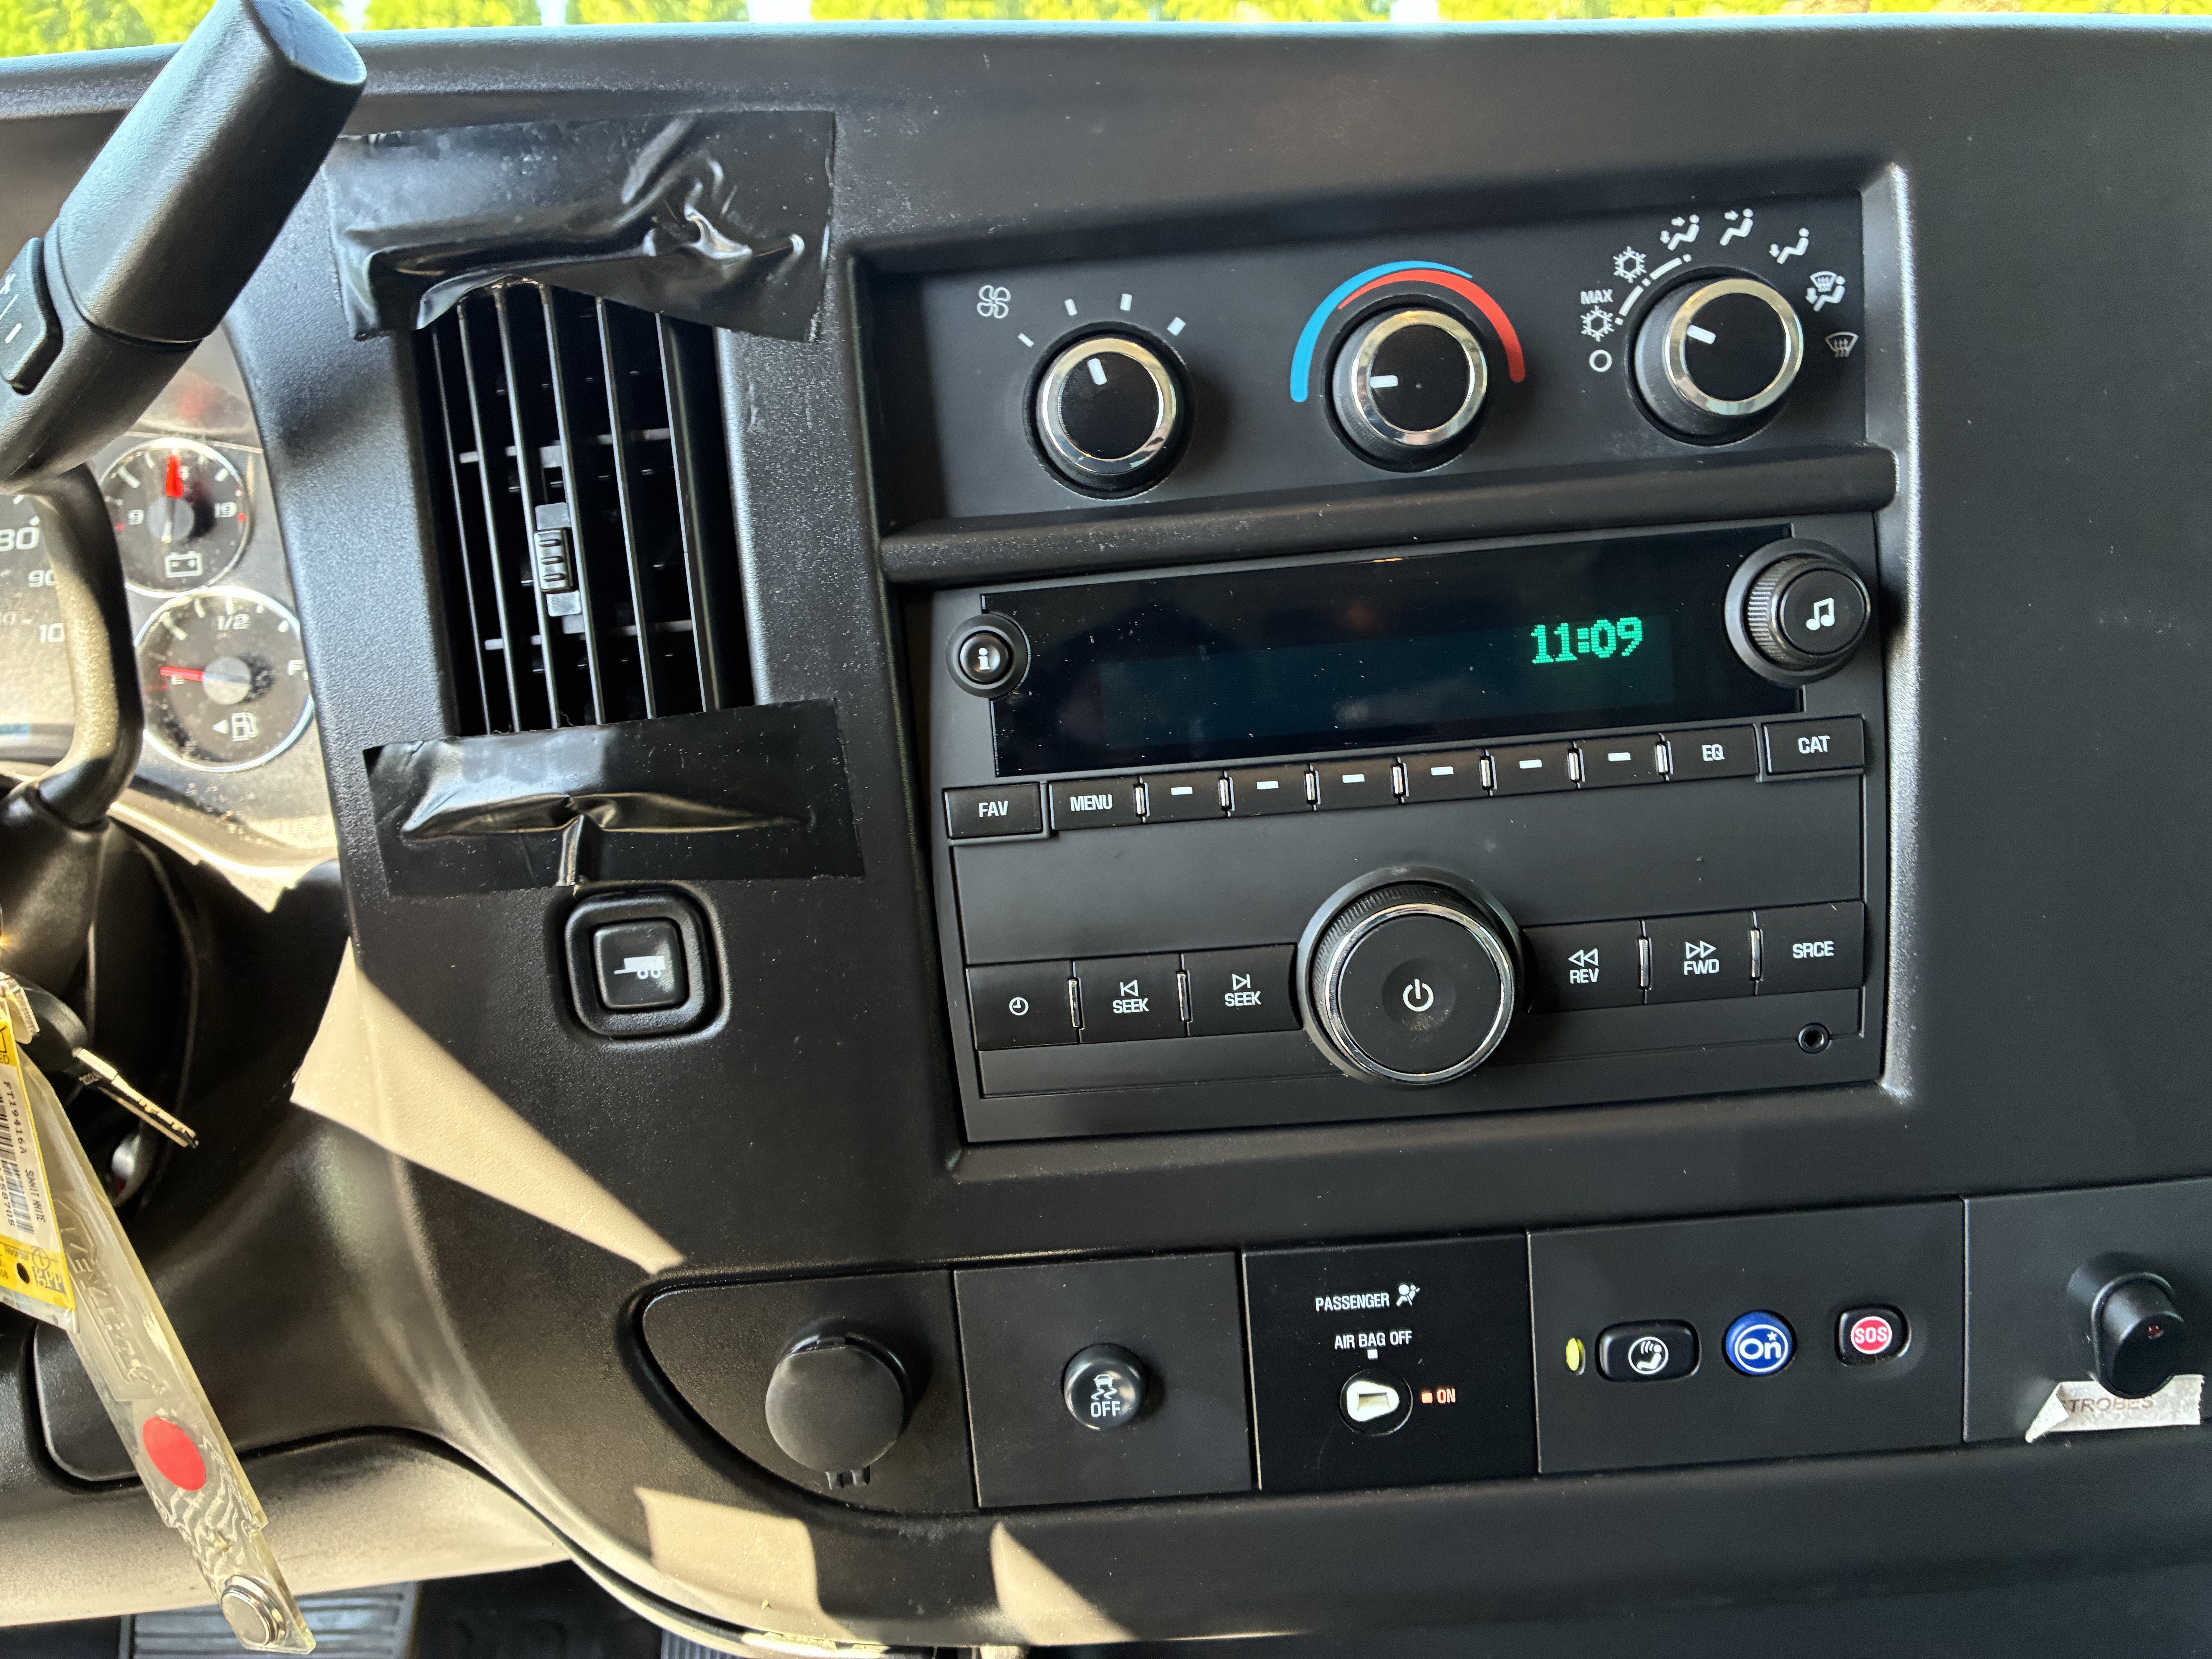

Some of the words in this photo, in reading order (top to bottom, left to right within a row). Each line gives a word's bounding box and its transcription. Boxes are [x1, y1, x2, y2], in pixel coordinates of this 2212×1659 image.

[1580, 289, 1614, 305] MAX
[1531, 617, 1643, 664] 11:09
[1702, 744, 1725, 762] EQ
[1798, 735, 1831, 754] CAT
[978, 800, 1009, 818] FAV
[1070, 794, 1113, 811] MENU
[1792, 941, 1834, 959] SRCE
[1683, 959, 1720, 975] FWD
[1570, 968, 1599, 984] REV
[1112, 998, 1149, 1014] SEEK
[1224, 991, 1262, 1007] SEEK
[1315, 1293, 1390, 1312] PASSENGER
[1334, 1334, 1355, 1350] AIR
[1358, 1332, 1386, 1348] BAG
[1389, 1330, 1413, 1346] OFF
[1855, 1326, 1888, 1344] SOS
[1436, 1388, 1456, 1404] ON
[1090, 1401, 1121, 1418] OFF
